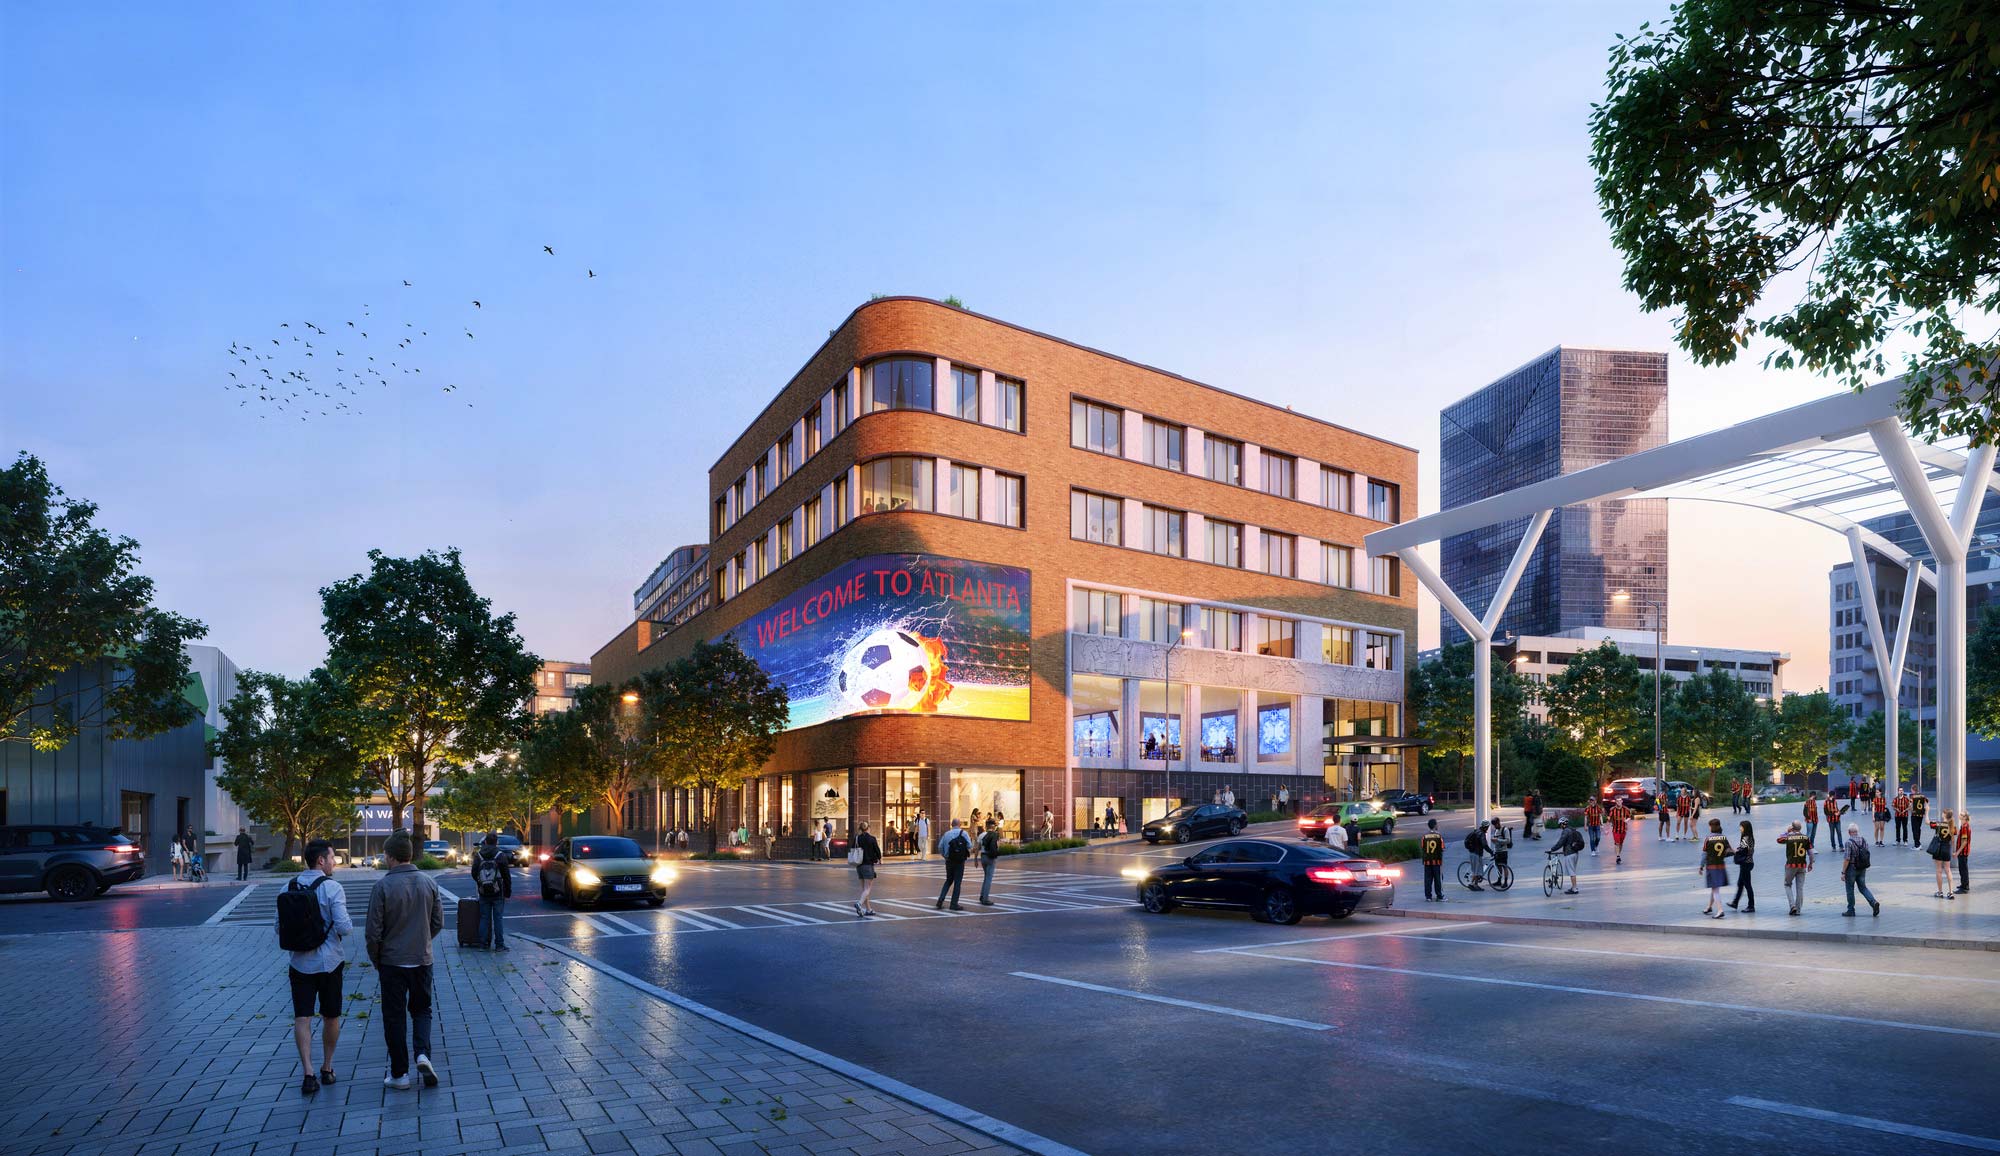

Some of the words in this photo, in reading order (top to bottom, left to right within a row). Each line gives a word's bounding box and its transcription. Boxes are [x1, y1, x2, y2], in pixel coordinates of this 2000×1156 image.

[757, 573, 866, 648] WELCOME
[873, 570, 913, 596] TO
[920, 571, 1022, 613] ATLANTA
[376, 809, 410, 819] WAK
[1426, 840, 1437, 854] 19
[1714, 842, 1725, 857] 9
[1793, 842, 1805, 858] 16
